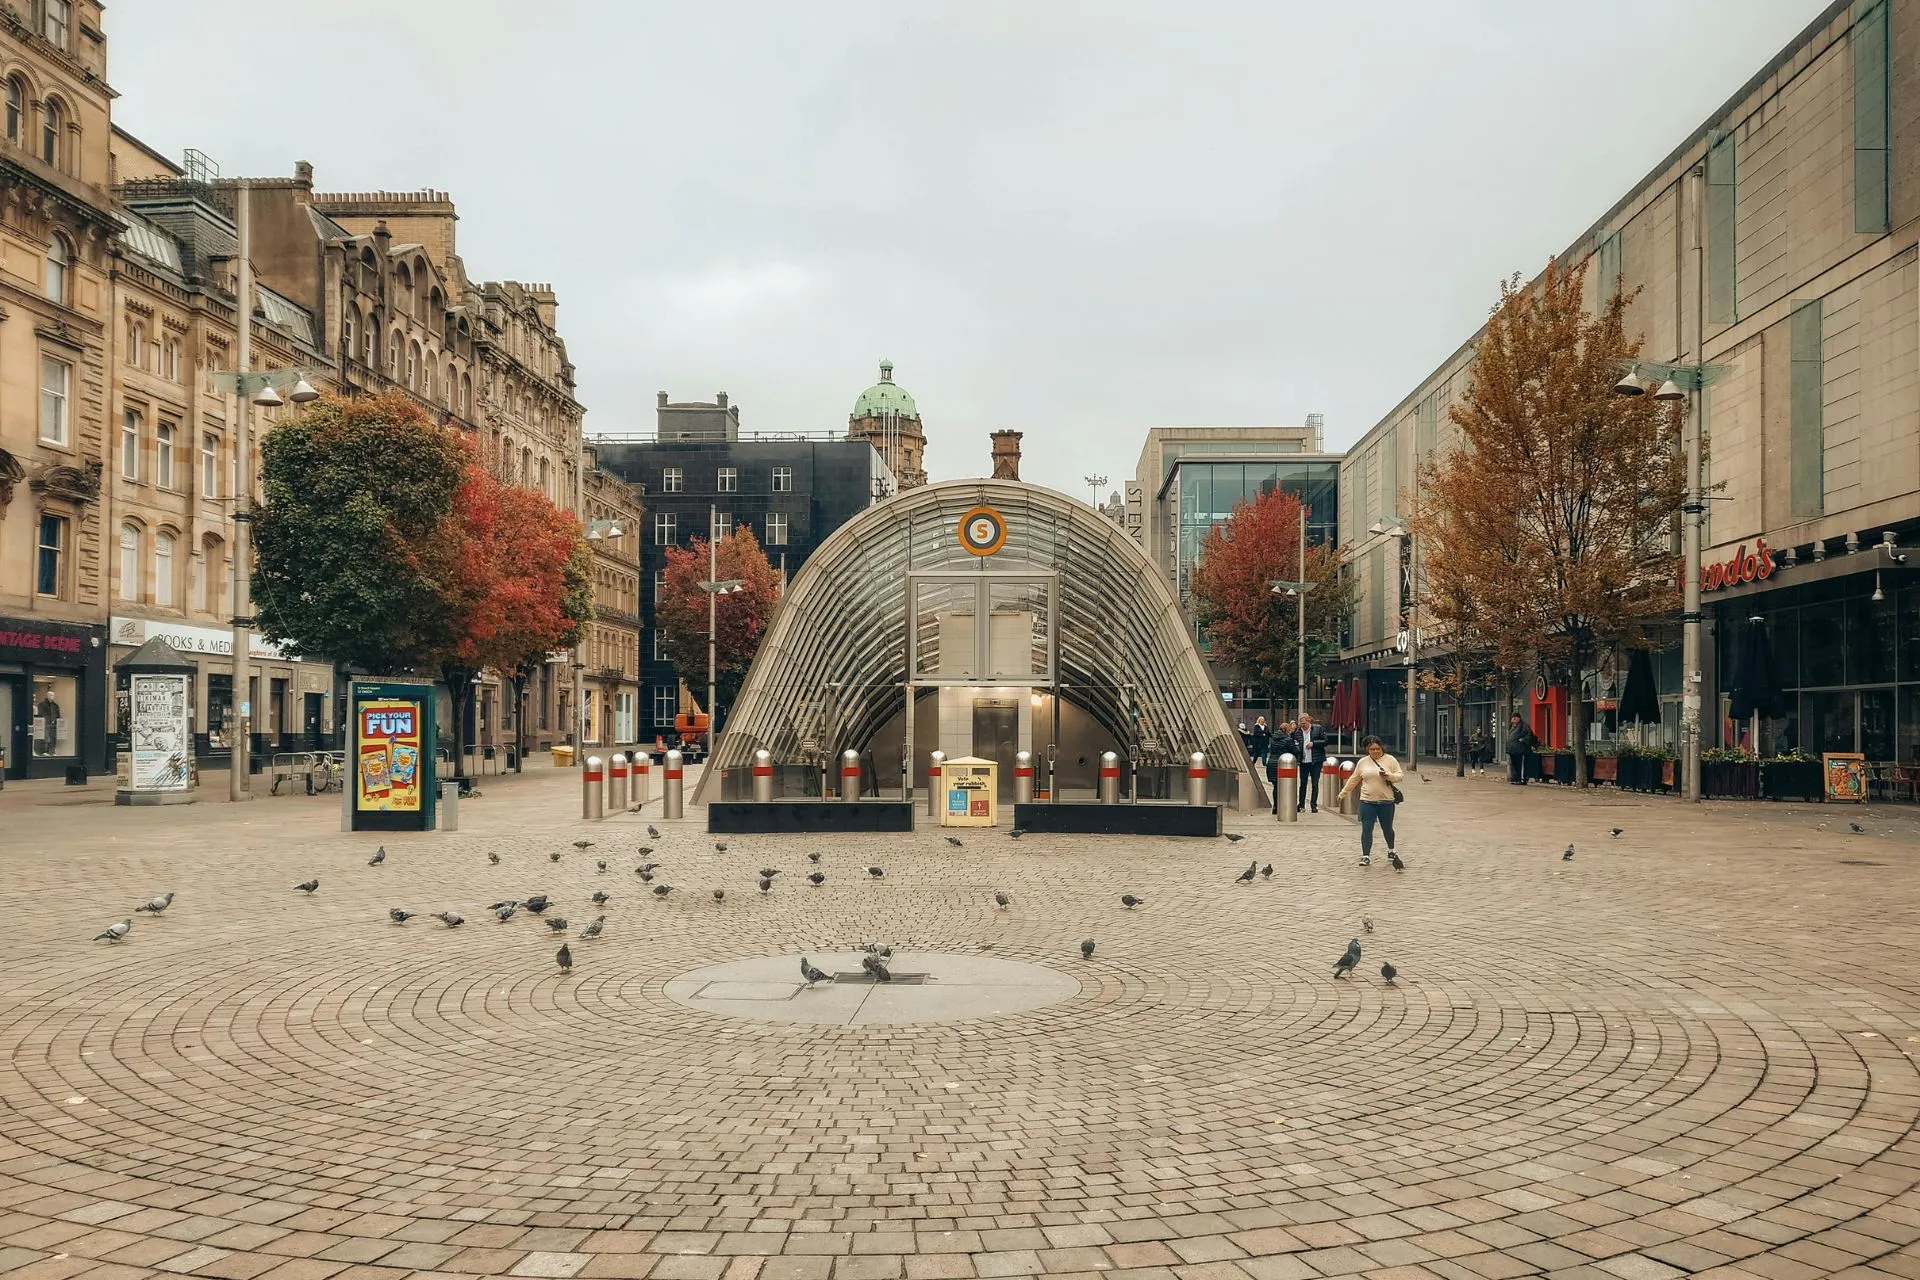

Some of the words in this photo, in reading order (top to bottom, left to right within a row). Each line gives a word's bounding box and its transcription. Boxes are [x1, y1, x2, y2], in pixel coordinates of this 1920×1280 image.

[1128, 487, 1142, 507] ST
[976, 523, 988, 539] S
[1128, 513, 1142, 546] EN
[1700, 538, 1773, 592] ndo's
[44, 634, 81, 653] SCENE
[198, 638, 205, 651] &
[210, 641, 233, 654] MEDI
[367, 719, 412, 735] FUN
